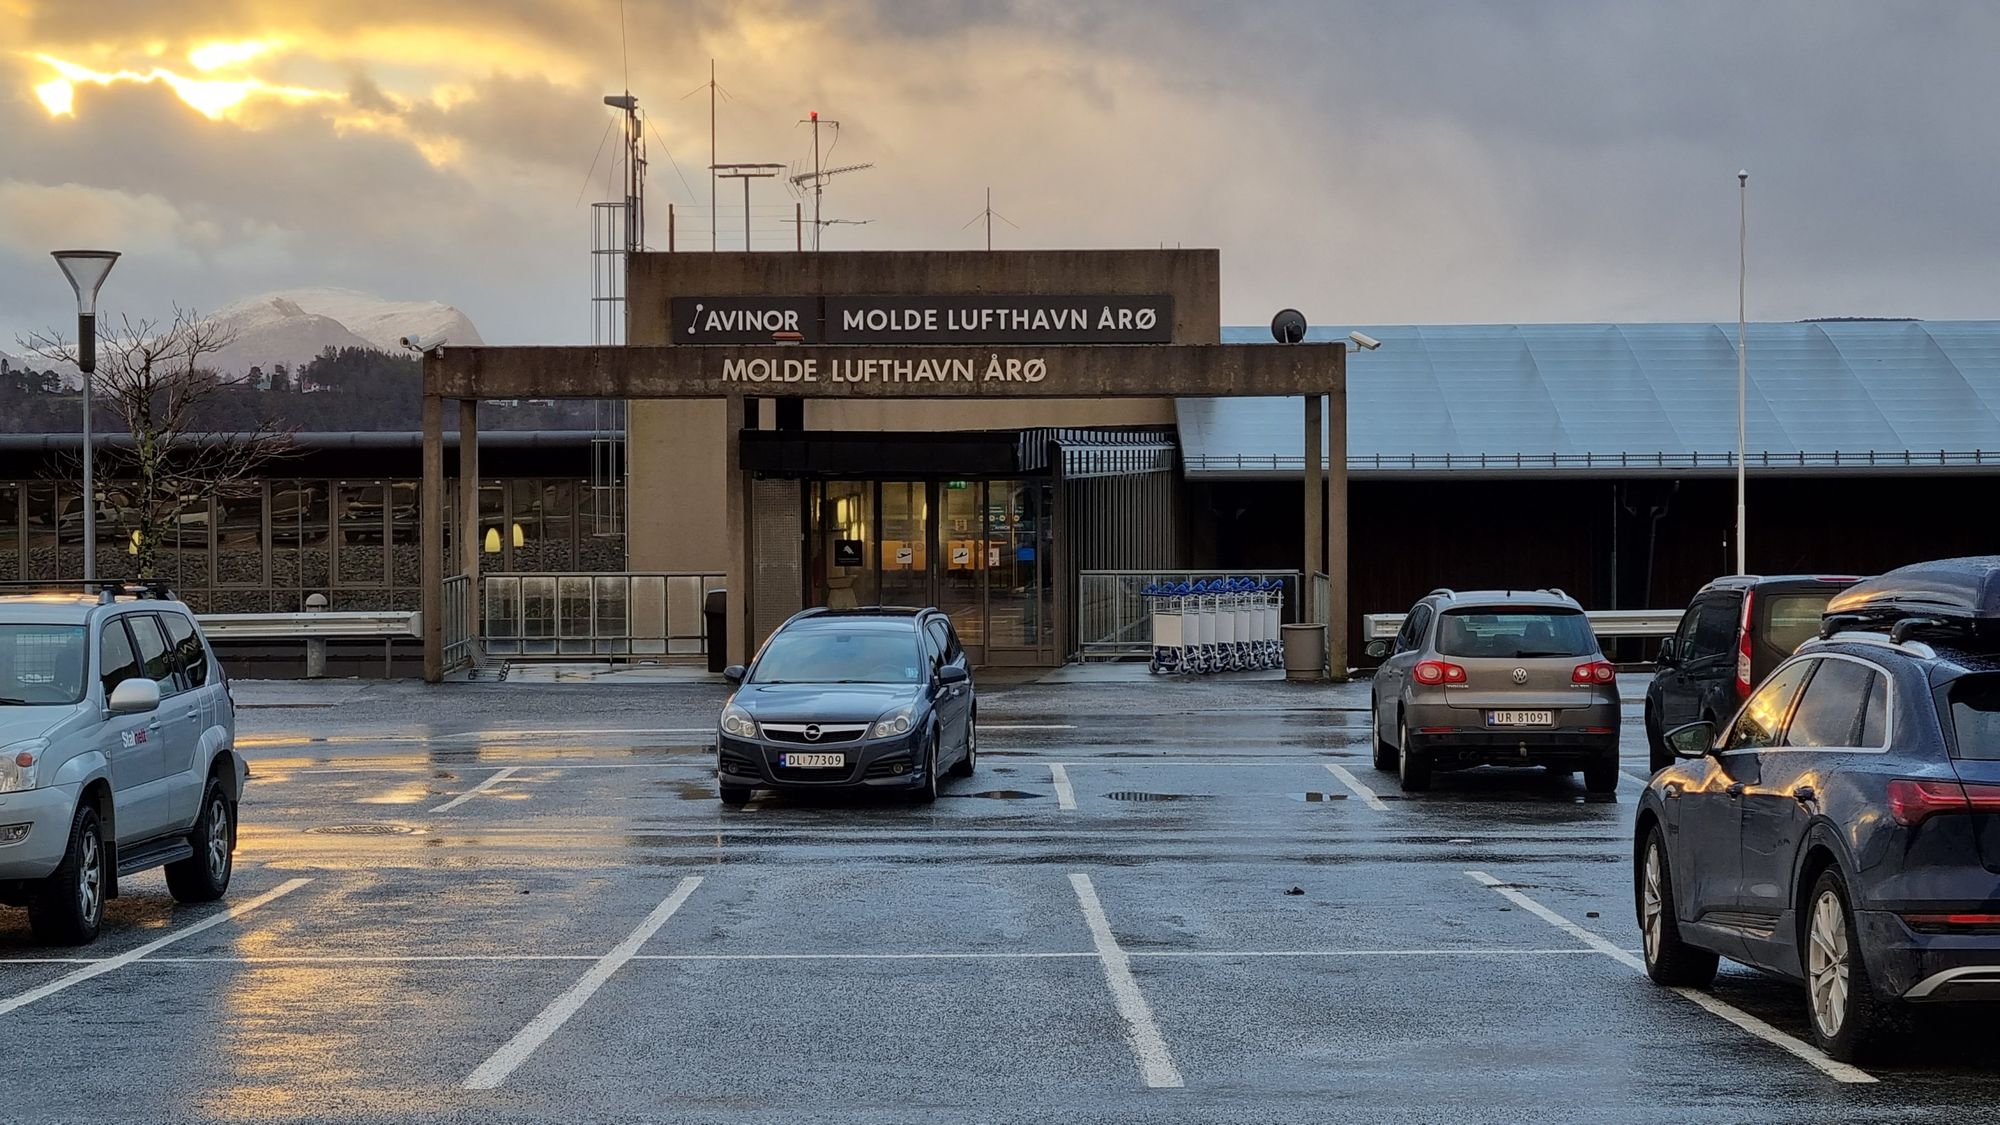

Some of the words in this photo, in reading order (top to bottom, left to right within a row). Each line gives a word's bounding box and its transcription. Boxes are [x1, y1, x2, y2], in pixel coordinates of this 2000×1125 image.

[704, 310, 799, 331] AVINOR
[843, 309, 938, 331] MOLDE
[948, 309, 1088, 331] LUFTHAVN
[1097, 306, 1157, 331] ÅRØ
[722, 358, 817, 382] MOLDE
[832, 359, 974, 382] LUFTHAVN
[984, 353, 1047, 383] ÅRØ
[1497, 712, 1512, 723] UR
[1517, 712, 1549, 723] 81091
[789, 755, 802, 765] DL
[808, 755, 841, 765] 77309
